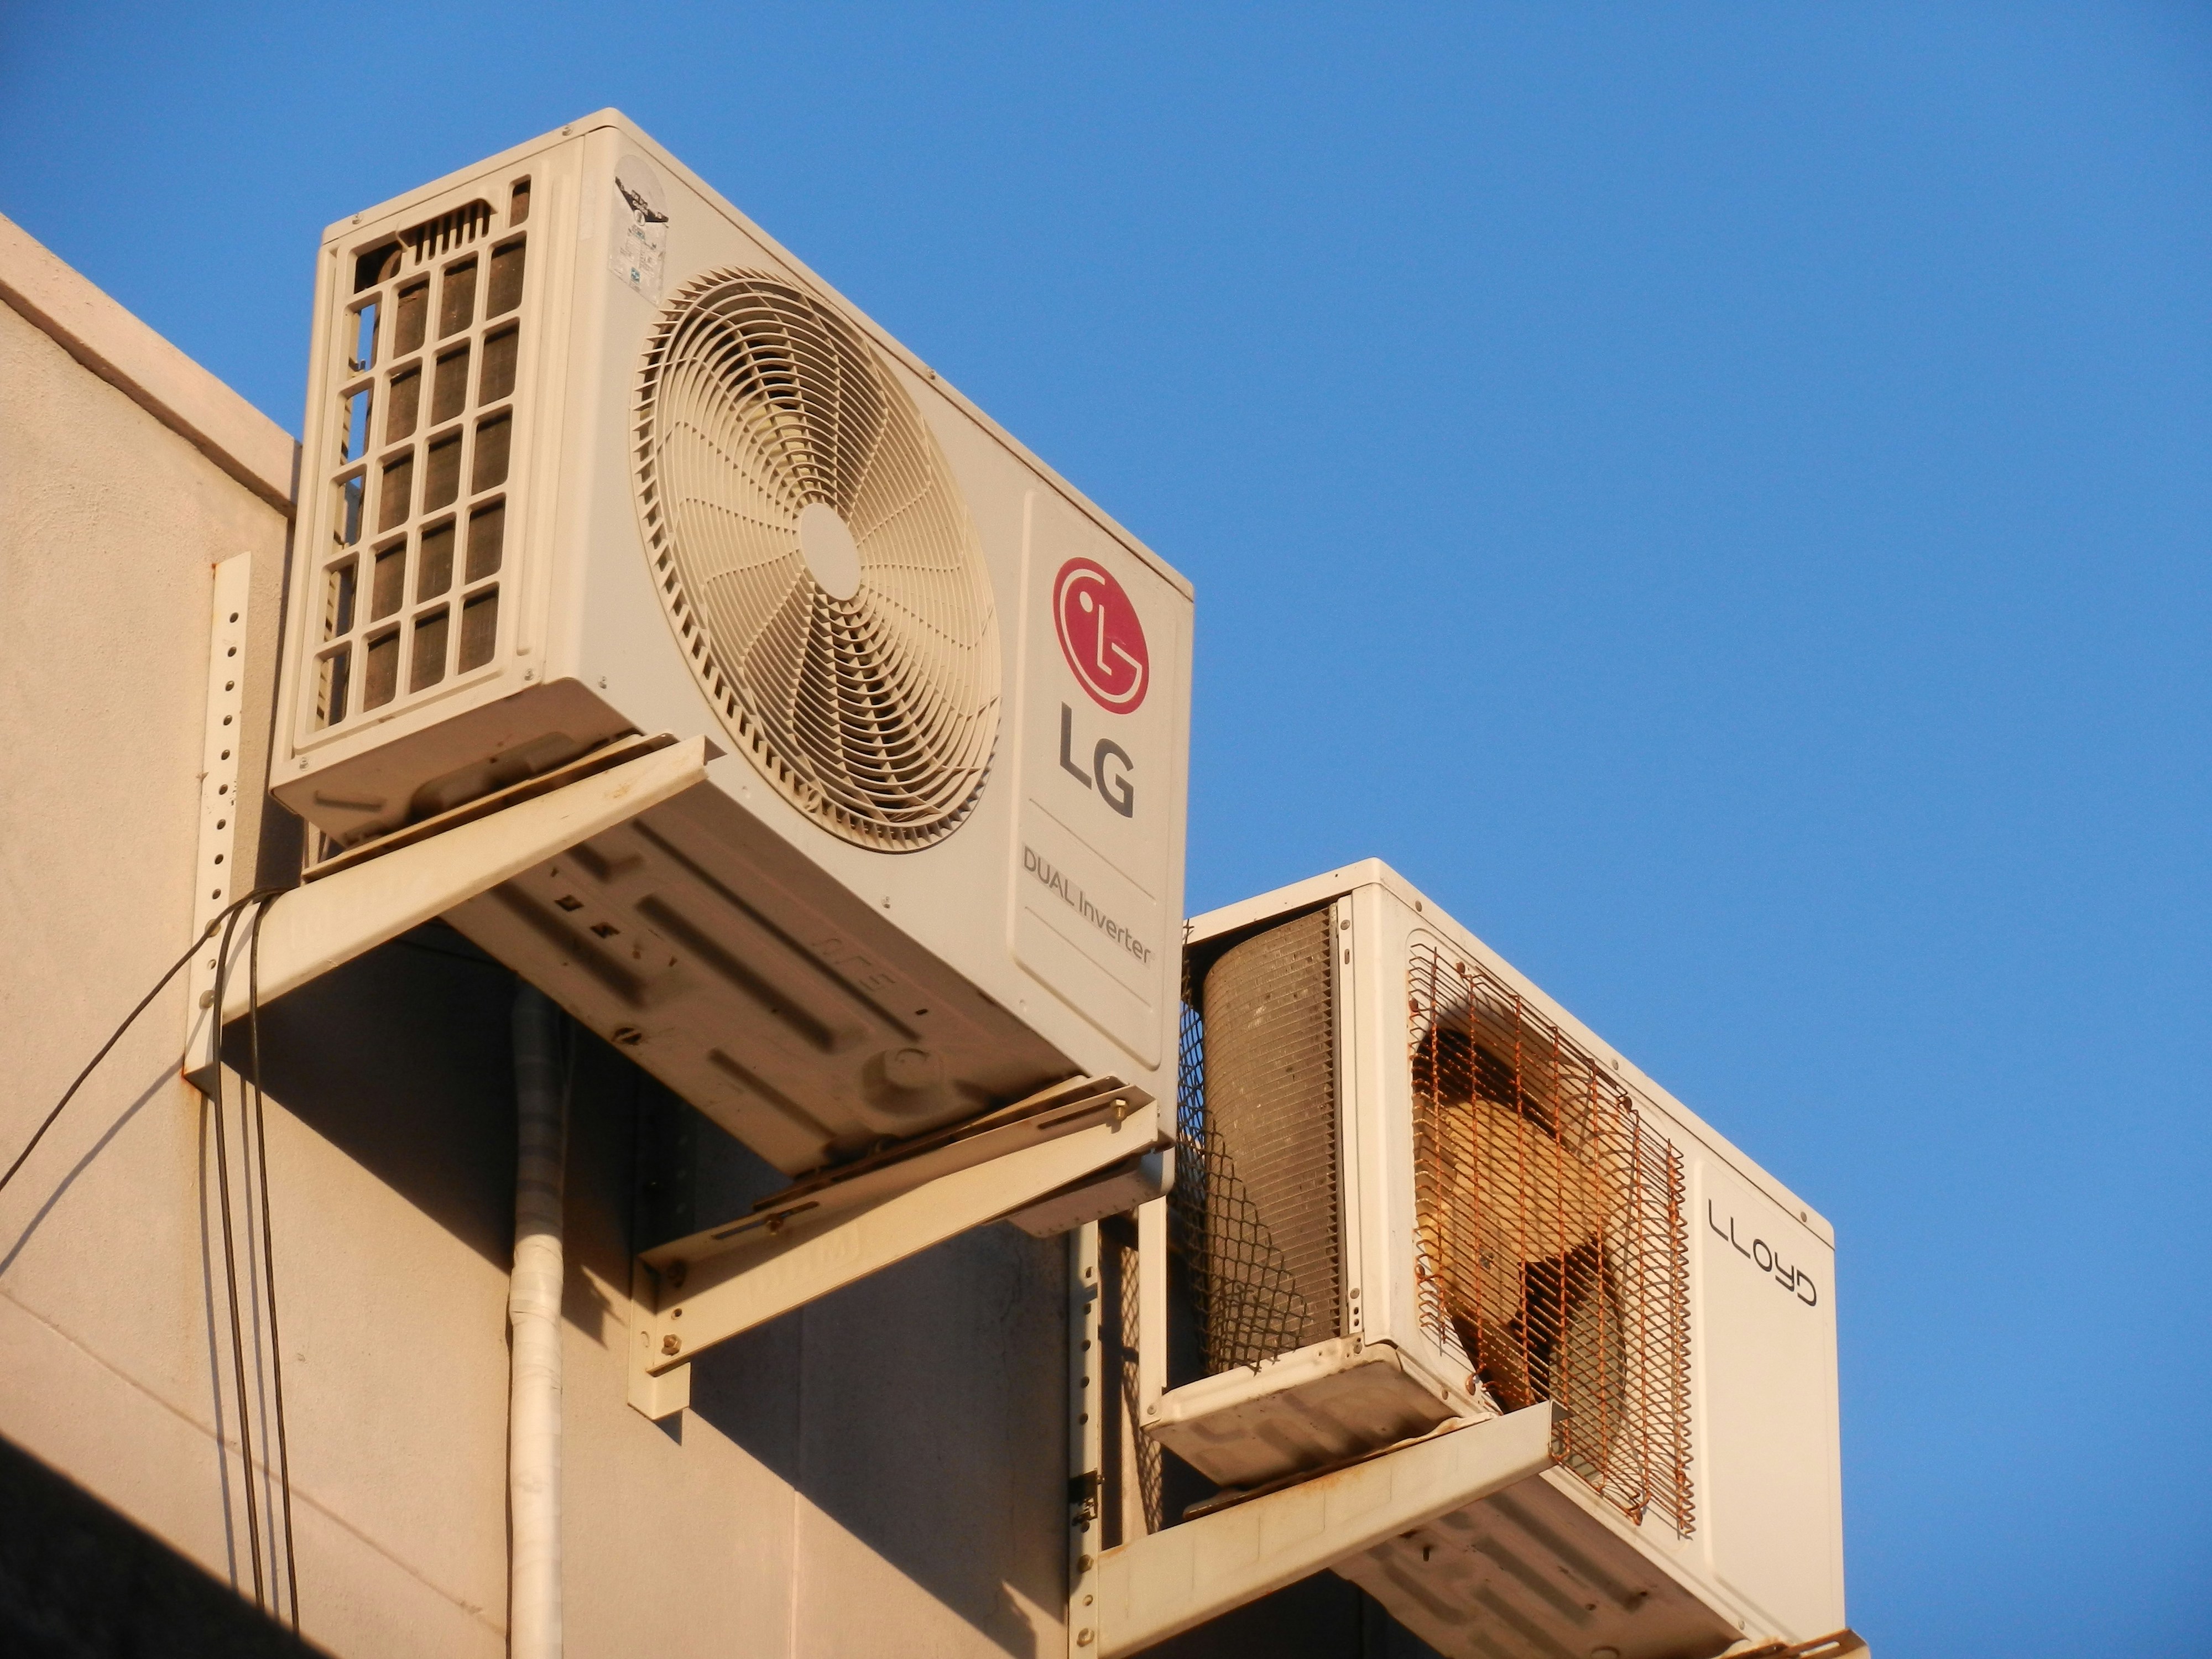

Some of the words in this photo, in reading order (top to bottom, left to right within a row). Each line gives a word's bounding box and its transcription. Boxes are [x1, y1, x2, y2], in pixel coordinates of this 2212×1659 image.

[1060, 700, 1134, 818] LG
[1024, 845, 1075, 907] DUAL
[1079, 890, 1151, 964] Inverter
[1708, 1197, 1817, 1307] LLOYD
